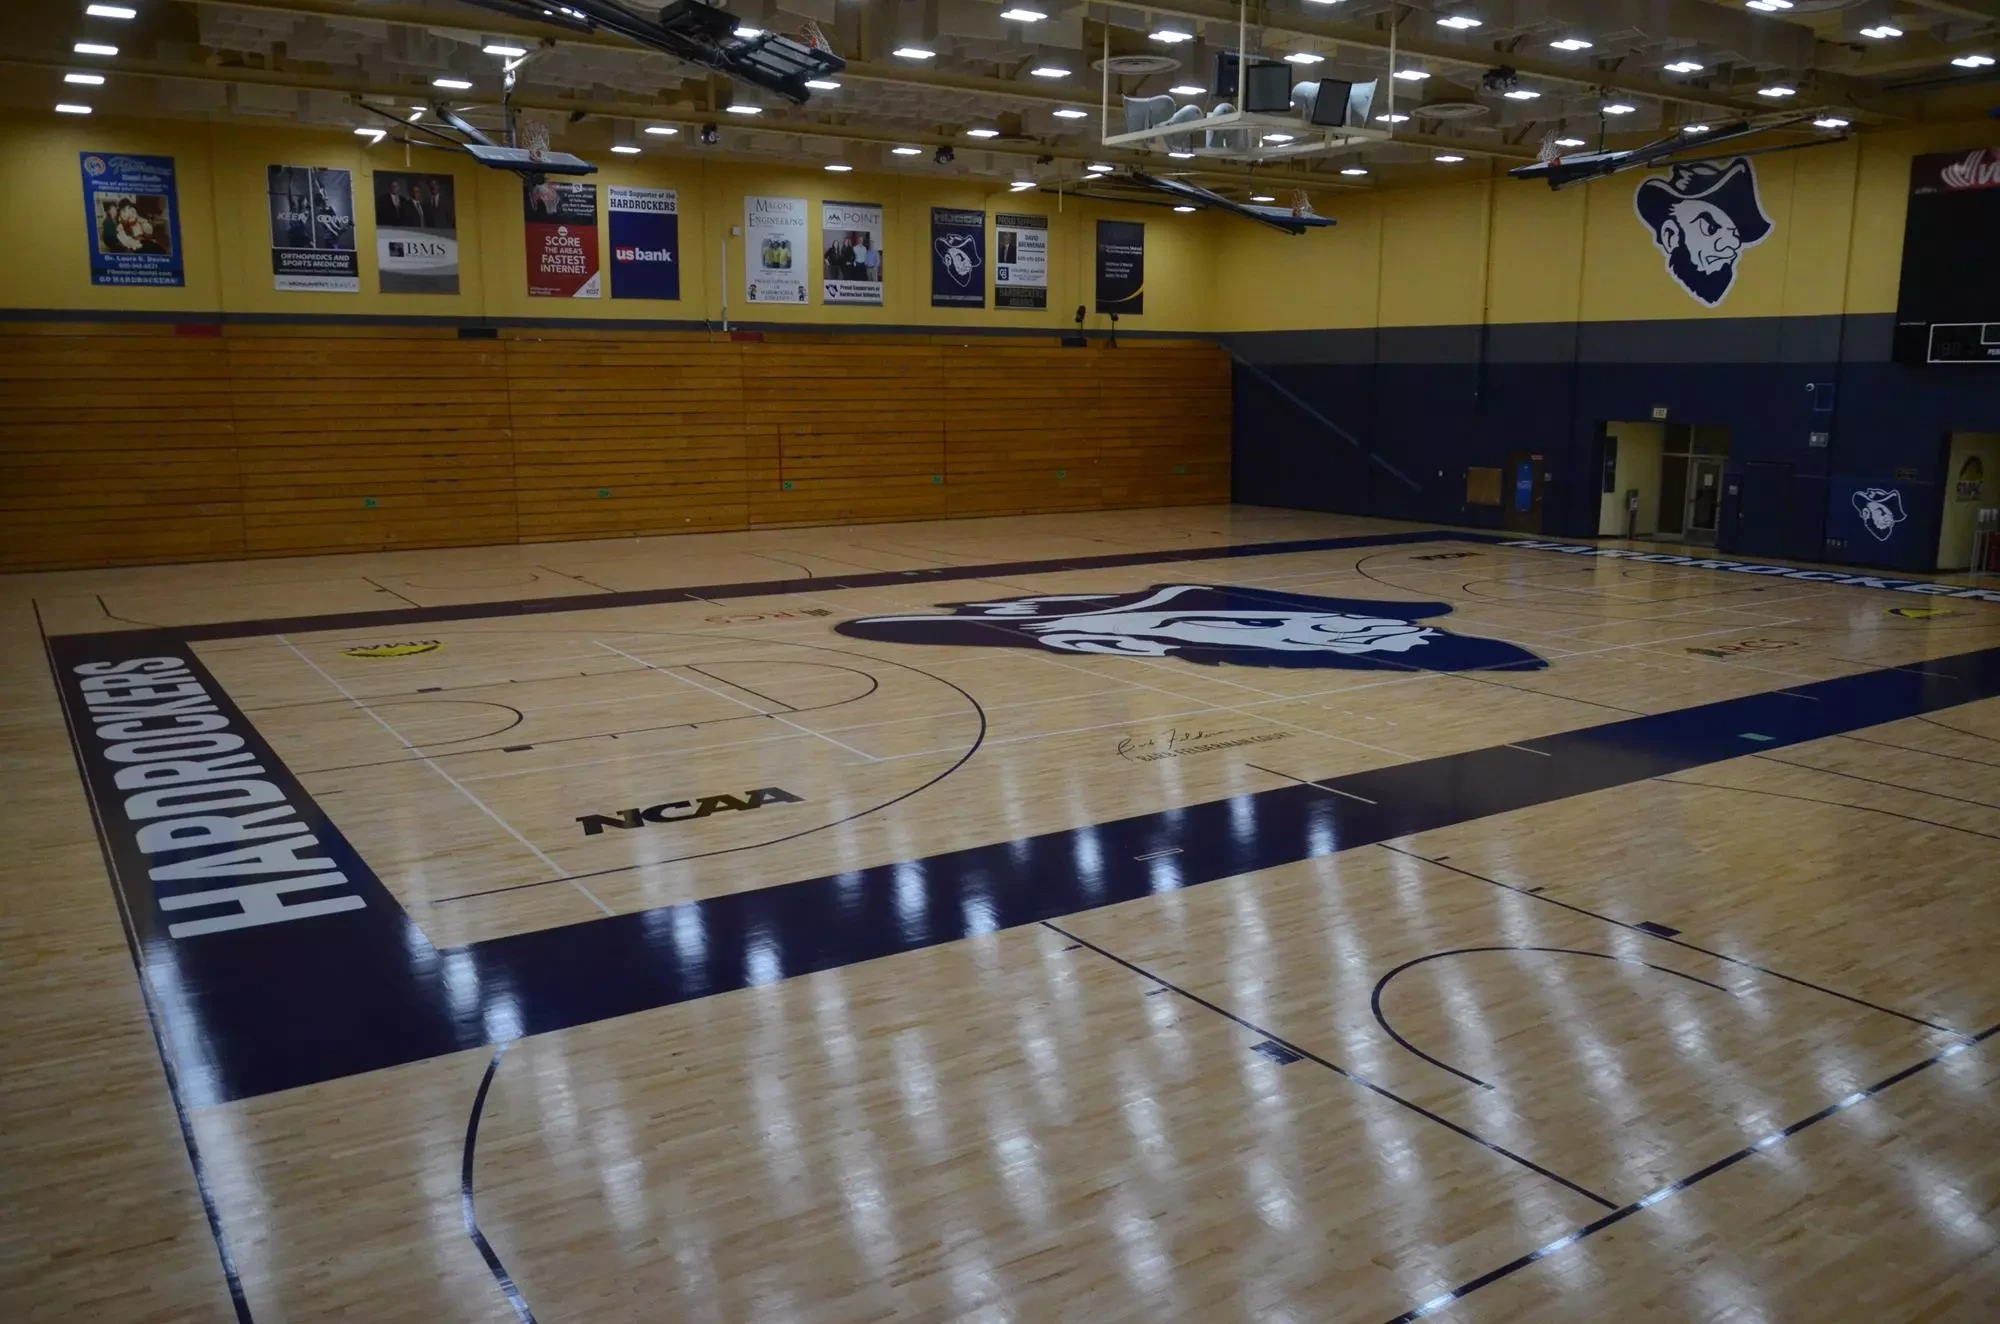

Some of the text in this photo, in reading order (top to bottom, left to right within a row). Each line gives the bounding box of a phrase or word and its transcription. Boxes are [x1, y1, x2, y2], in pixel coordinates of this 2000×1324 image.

[629, 190, 657, 199] Supporter
[610, 198, 675, 211] HARDROCKERS
[844, 212, 880, 224] POINT
[545, 236, 580, 246] SCORE
[407, 243, 446, 255] BMS
[280, 253, 332, 261] ORTHOPEDICS
[541, 254, 586, 265] FASTEST
[313, 260, 349, 268] MEDICINE
[540, 264, 588, 274] INTERNET.
[72, 656, 368, 939] HARDROCKERS
[575, 786, 806, 836] NCAA
